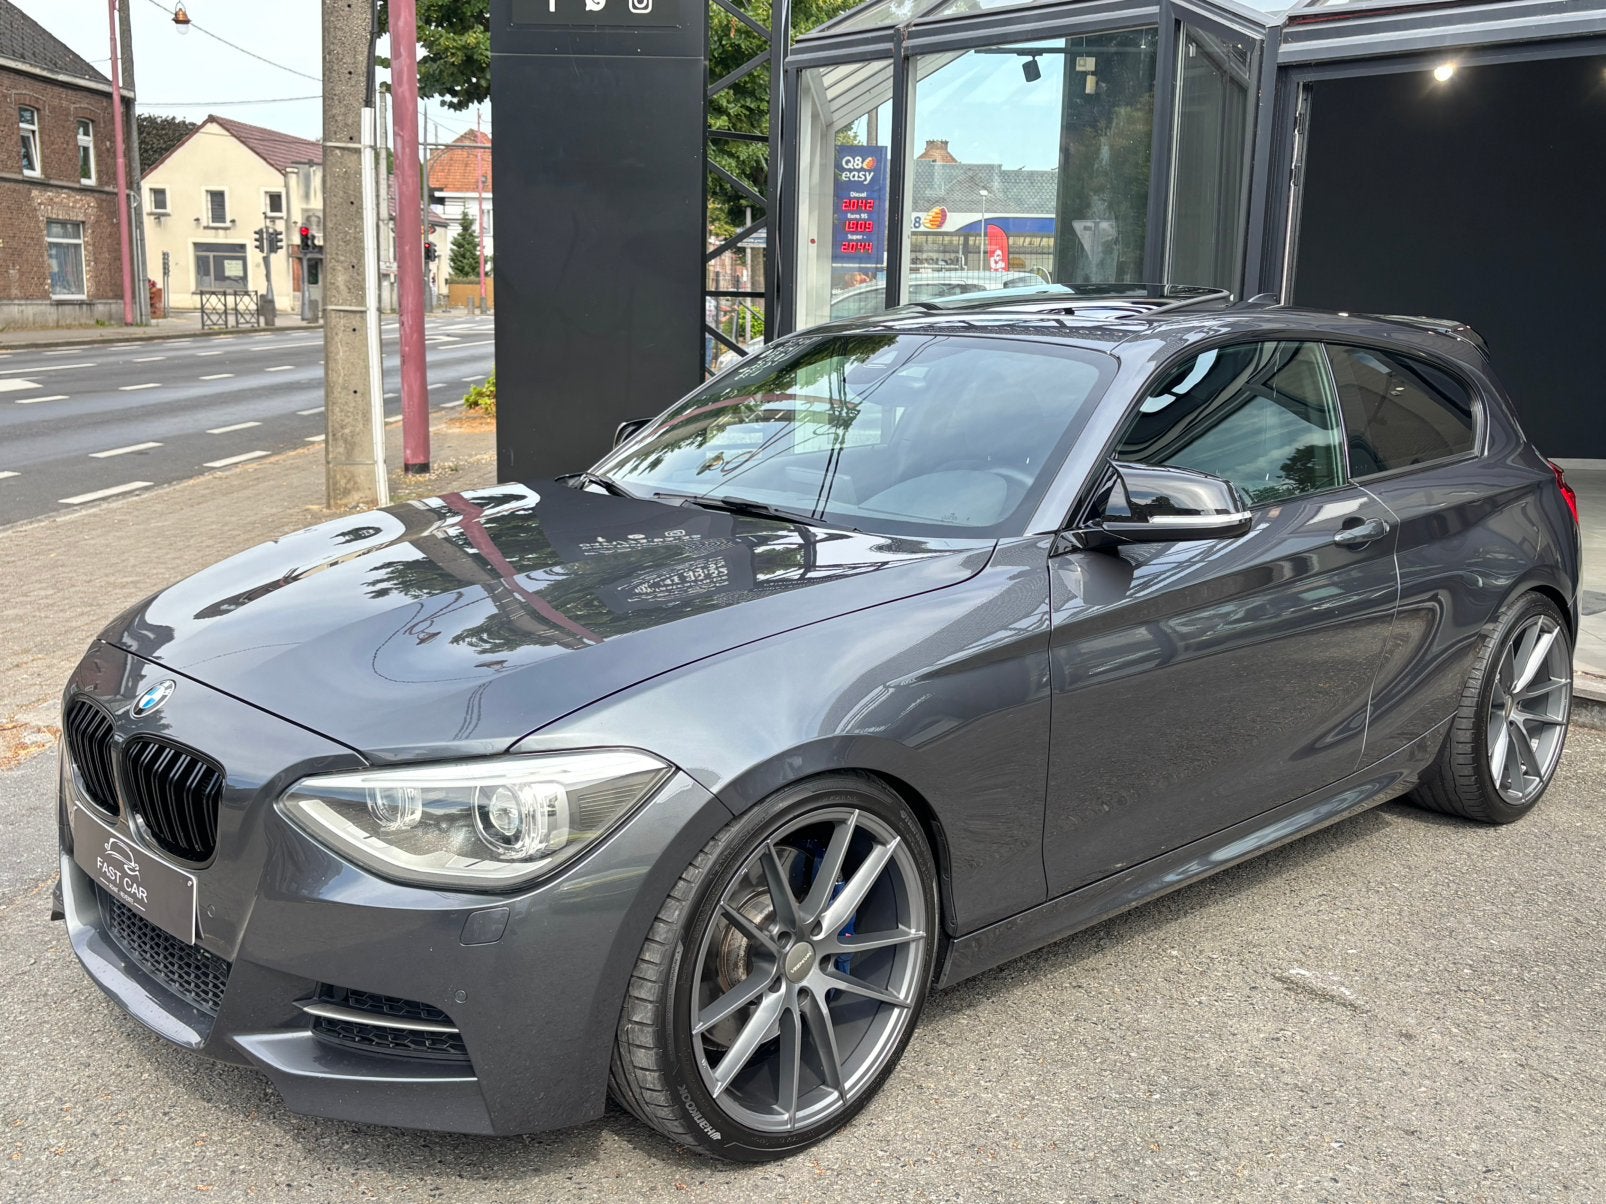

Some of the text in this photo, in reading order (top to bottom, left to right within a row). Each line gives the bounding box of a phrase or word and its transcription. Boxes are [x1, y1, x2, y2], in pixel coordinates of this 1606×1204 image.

[842, 156, 863, 169] Q8
[842, 171, 874, 184] easy
[97, 856, 122, 884] FAST
[123, 878, 148, 903] CAR
